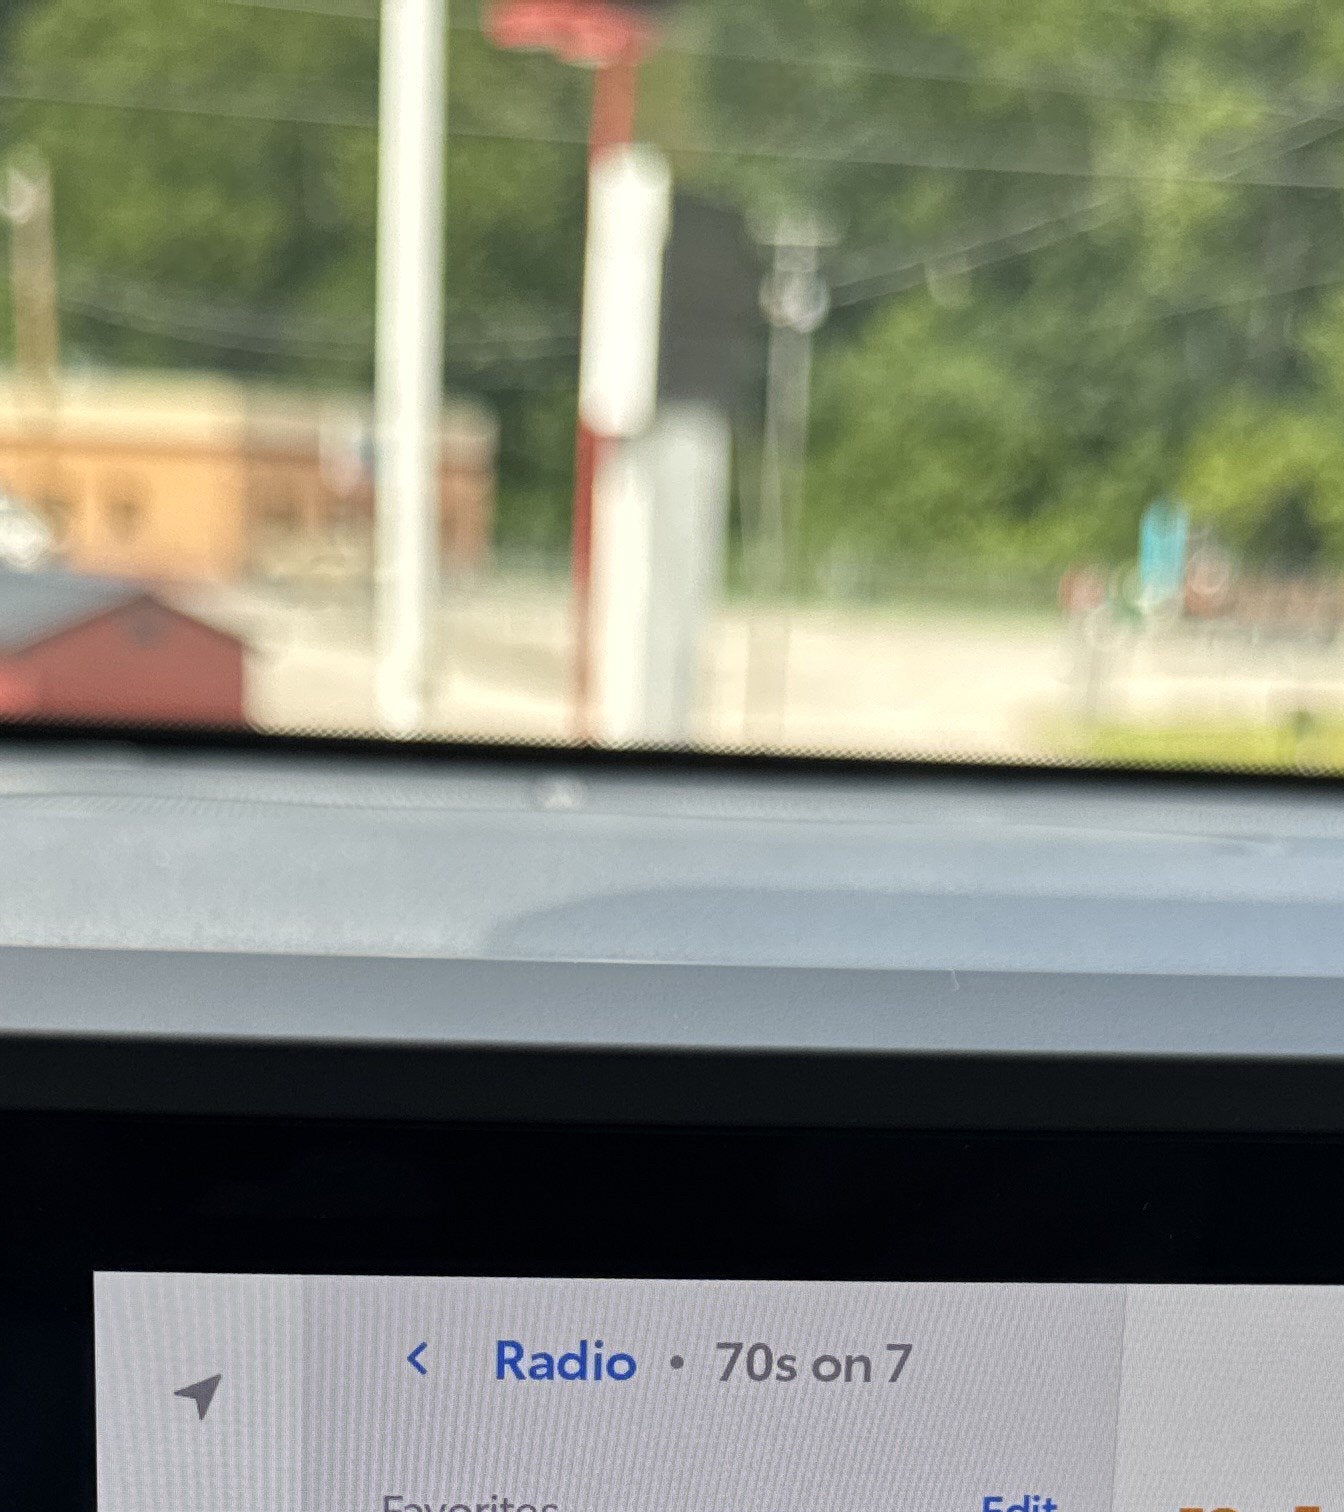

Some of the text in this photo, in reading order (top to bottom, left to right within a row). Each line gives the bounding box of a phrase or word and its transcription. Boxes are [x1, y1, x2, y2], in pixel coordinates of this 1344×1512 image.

[494, 1340, 914, 1383] Radio 70s on 7
